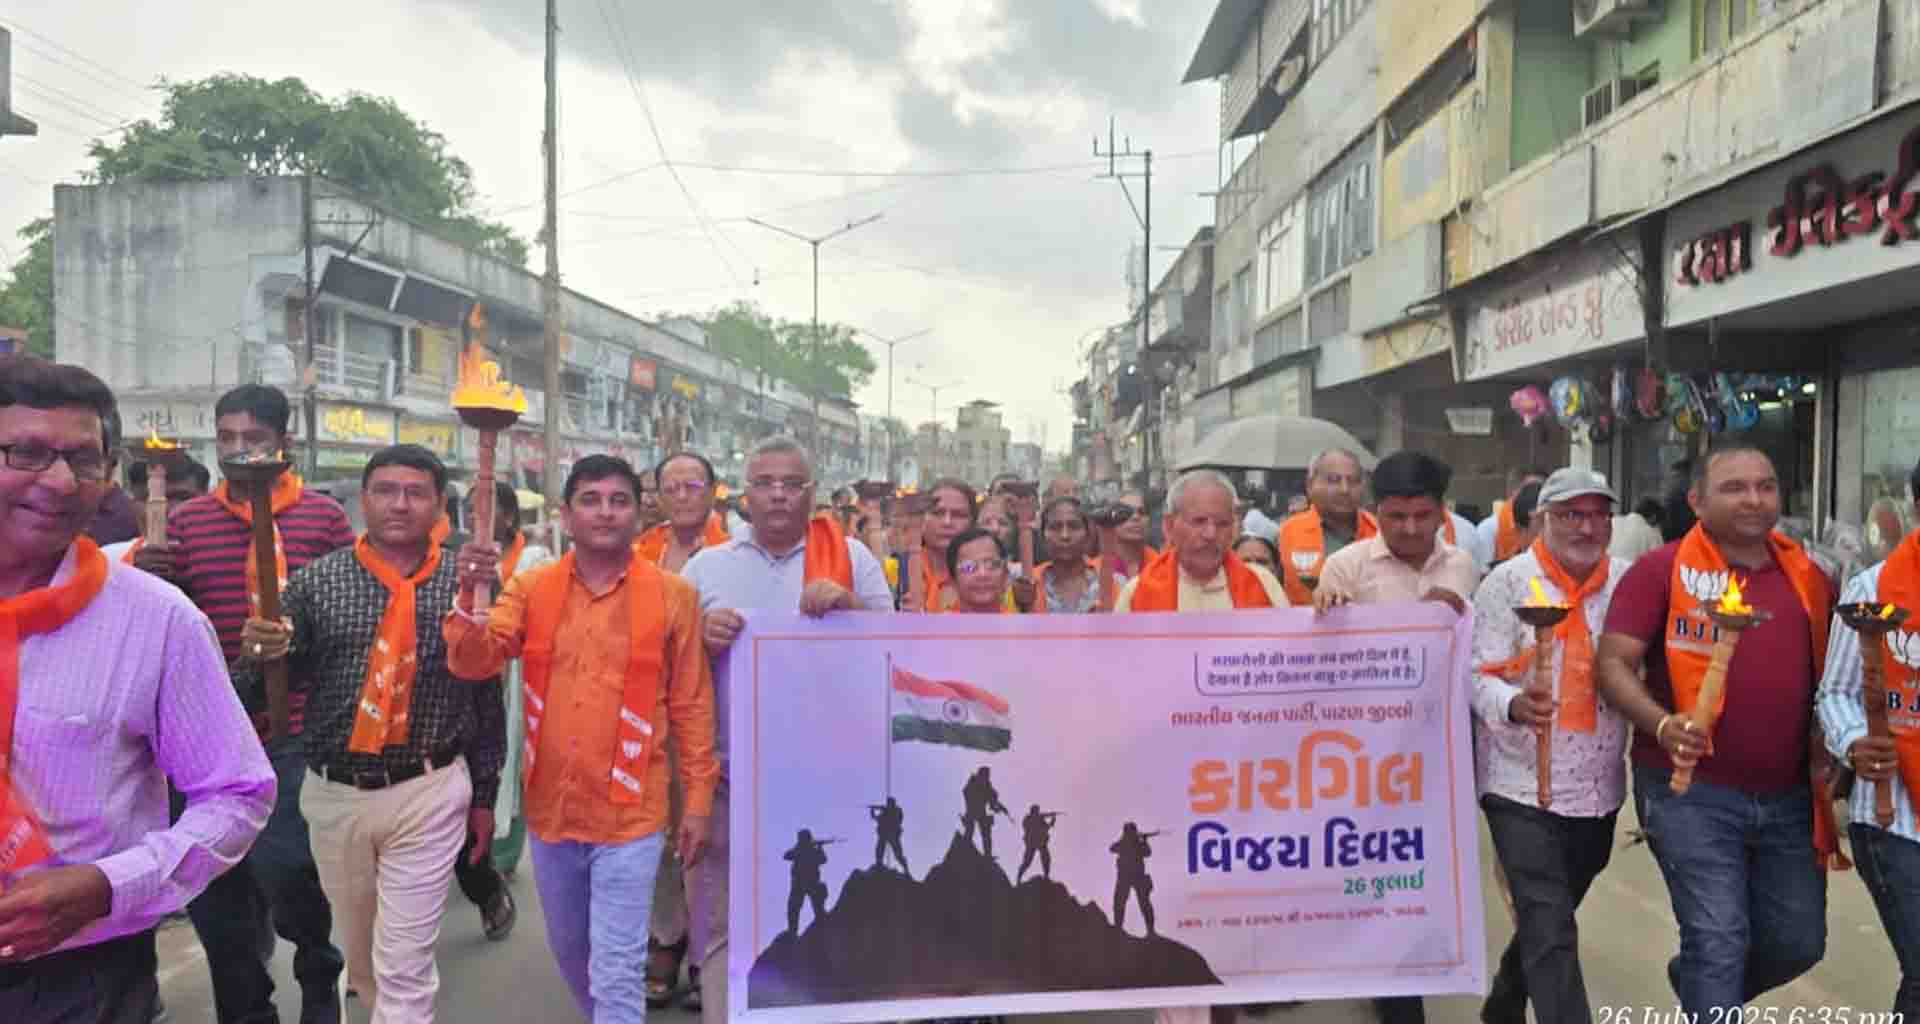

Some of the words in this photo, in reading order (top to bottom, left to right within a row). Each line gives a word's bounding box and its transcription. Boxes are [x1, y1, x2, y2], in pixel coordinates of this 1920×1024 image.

[1188, 730, 1424, 815] કારગિલ
[1187, 820, 1311, 875] વિજય
[1324, 817, 1424, 868] દિવસ
[1343, 876, 1366, 895] 26
